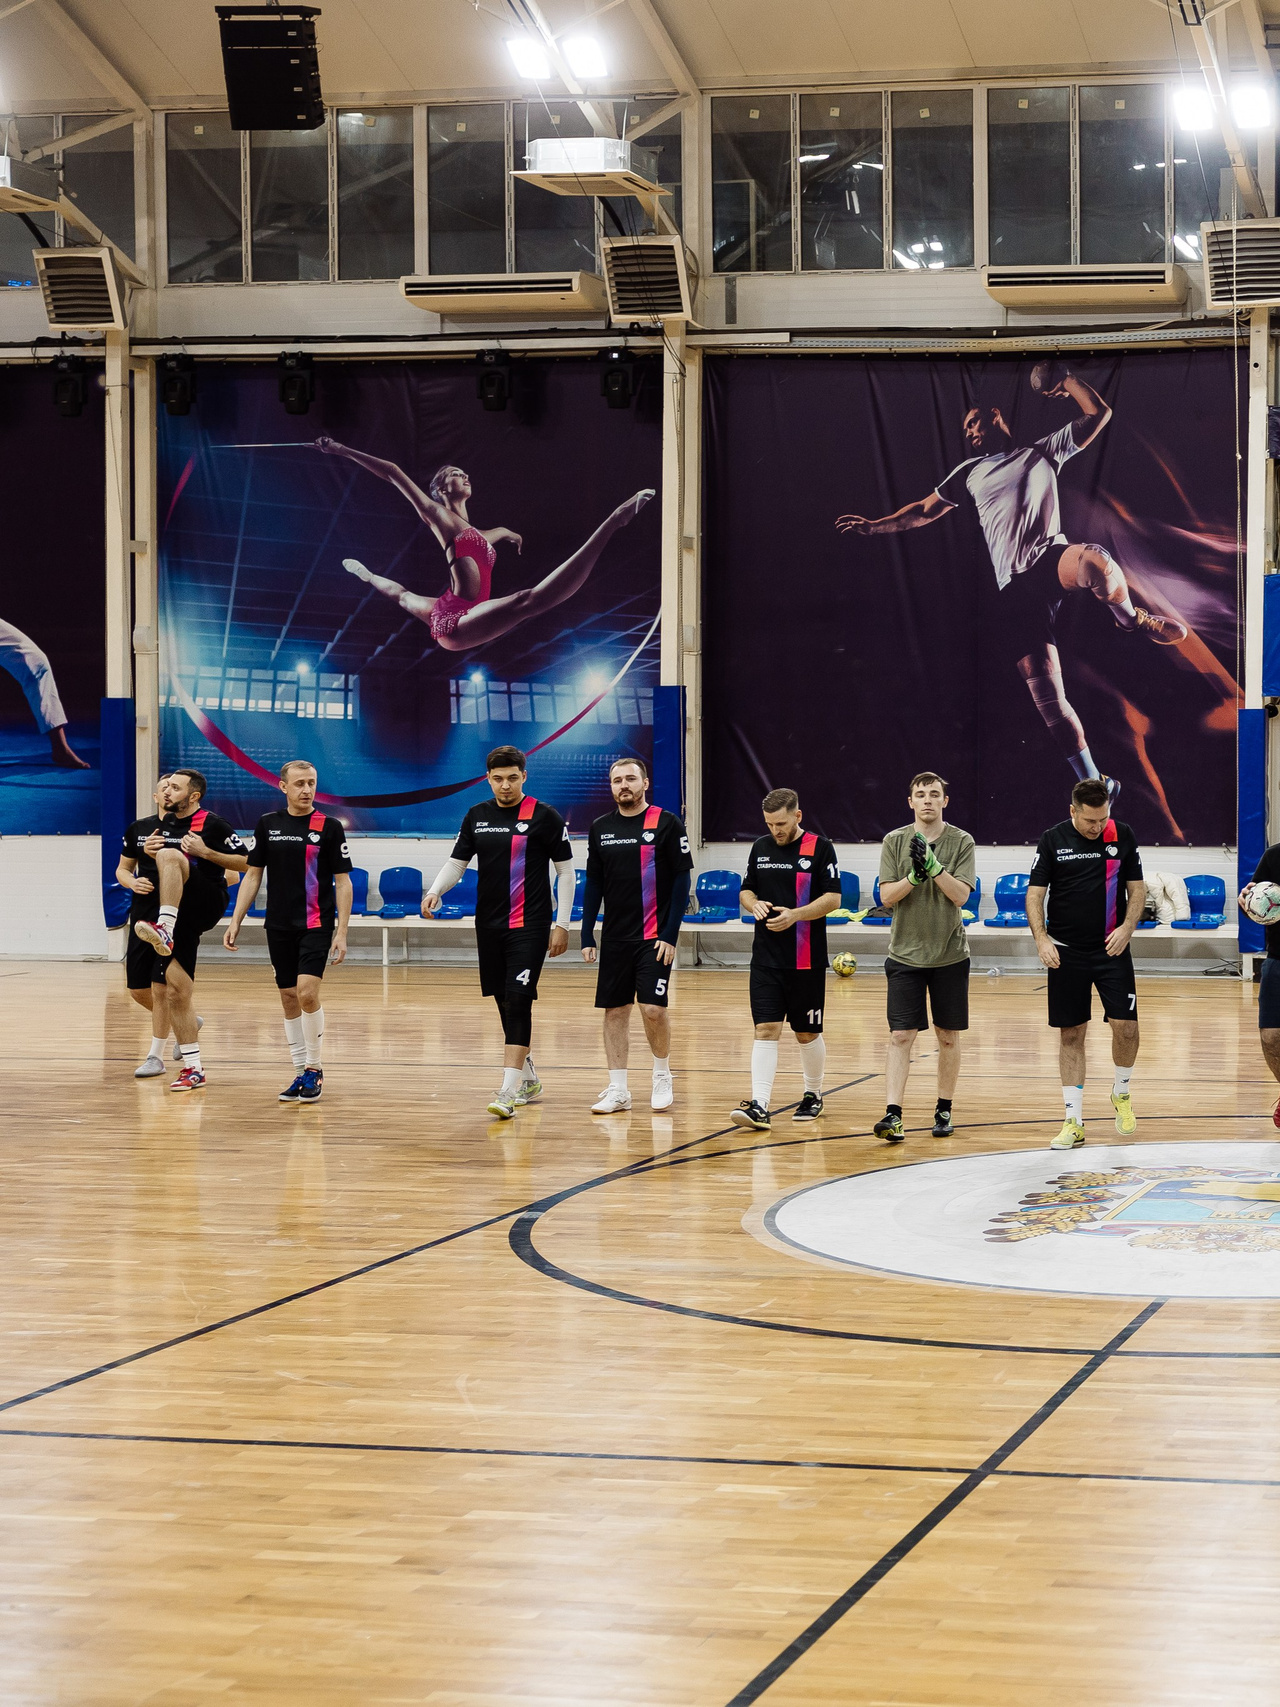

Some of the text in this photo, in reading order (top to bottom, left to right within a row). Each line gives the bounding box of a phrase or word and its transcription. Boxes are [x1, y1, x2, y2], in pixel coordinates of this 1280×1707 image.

[224, 833, 243, 850] 13
[679, 836, 691, 854] 5
[340, 842, 351, 859] 9
[1056, 852, 1101, 862] СТАВРОПОЛЬ
[515, 968, 531, 986] 4
[654, 978, 668, 996] 5
[1127, 993, 1136, 1011] 7
[806, 1008, 822, 1025] 11
